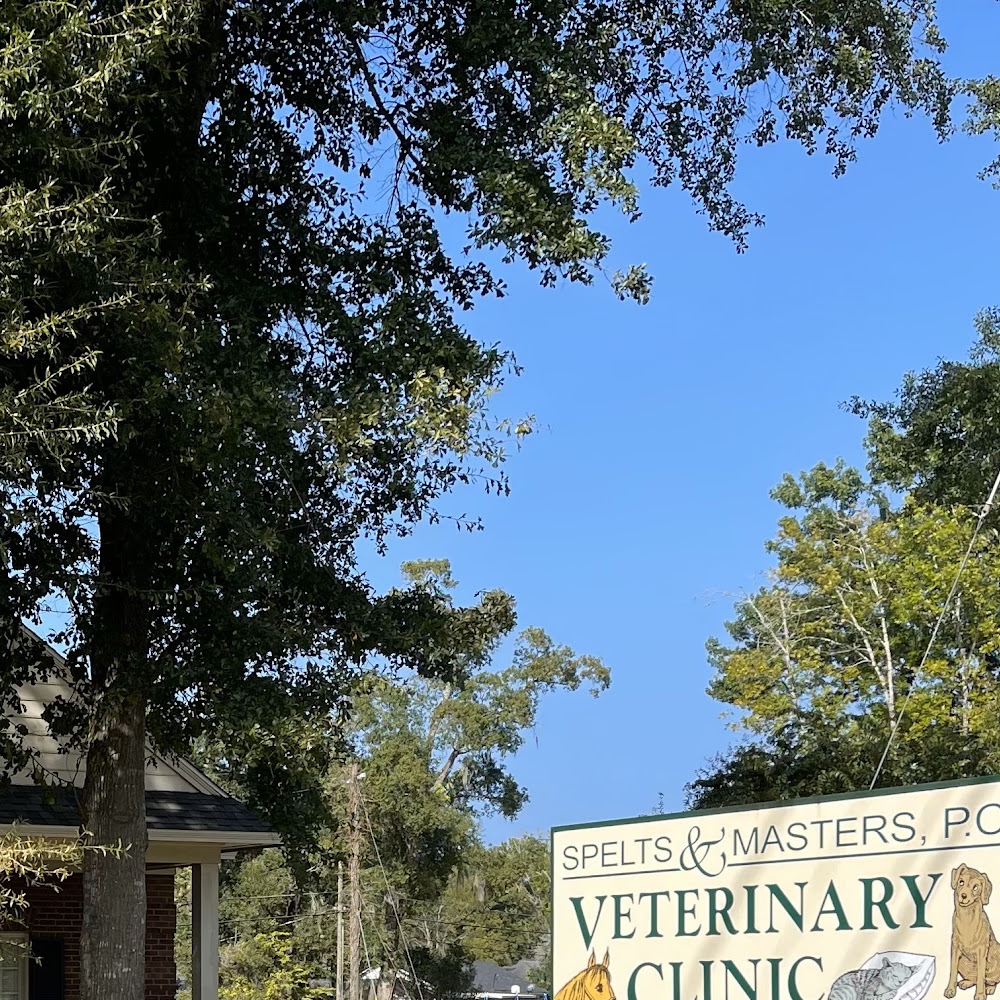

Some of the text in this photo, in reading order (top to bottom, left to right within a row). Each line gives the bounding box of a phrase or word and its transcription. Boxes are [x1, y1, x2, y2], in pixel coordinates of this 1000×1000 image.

[562, 836, 673, 870] SPELTS
[679, 825, 725, 877] &
[733, 811, 927, 856] MASTERS,
[569, 872, 943, 951] VETERINARY
